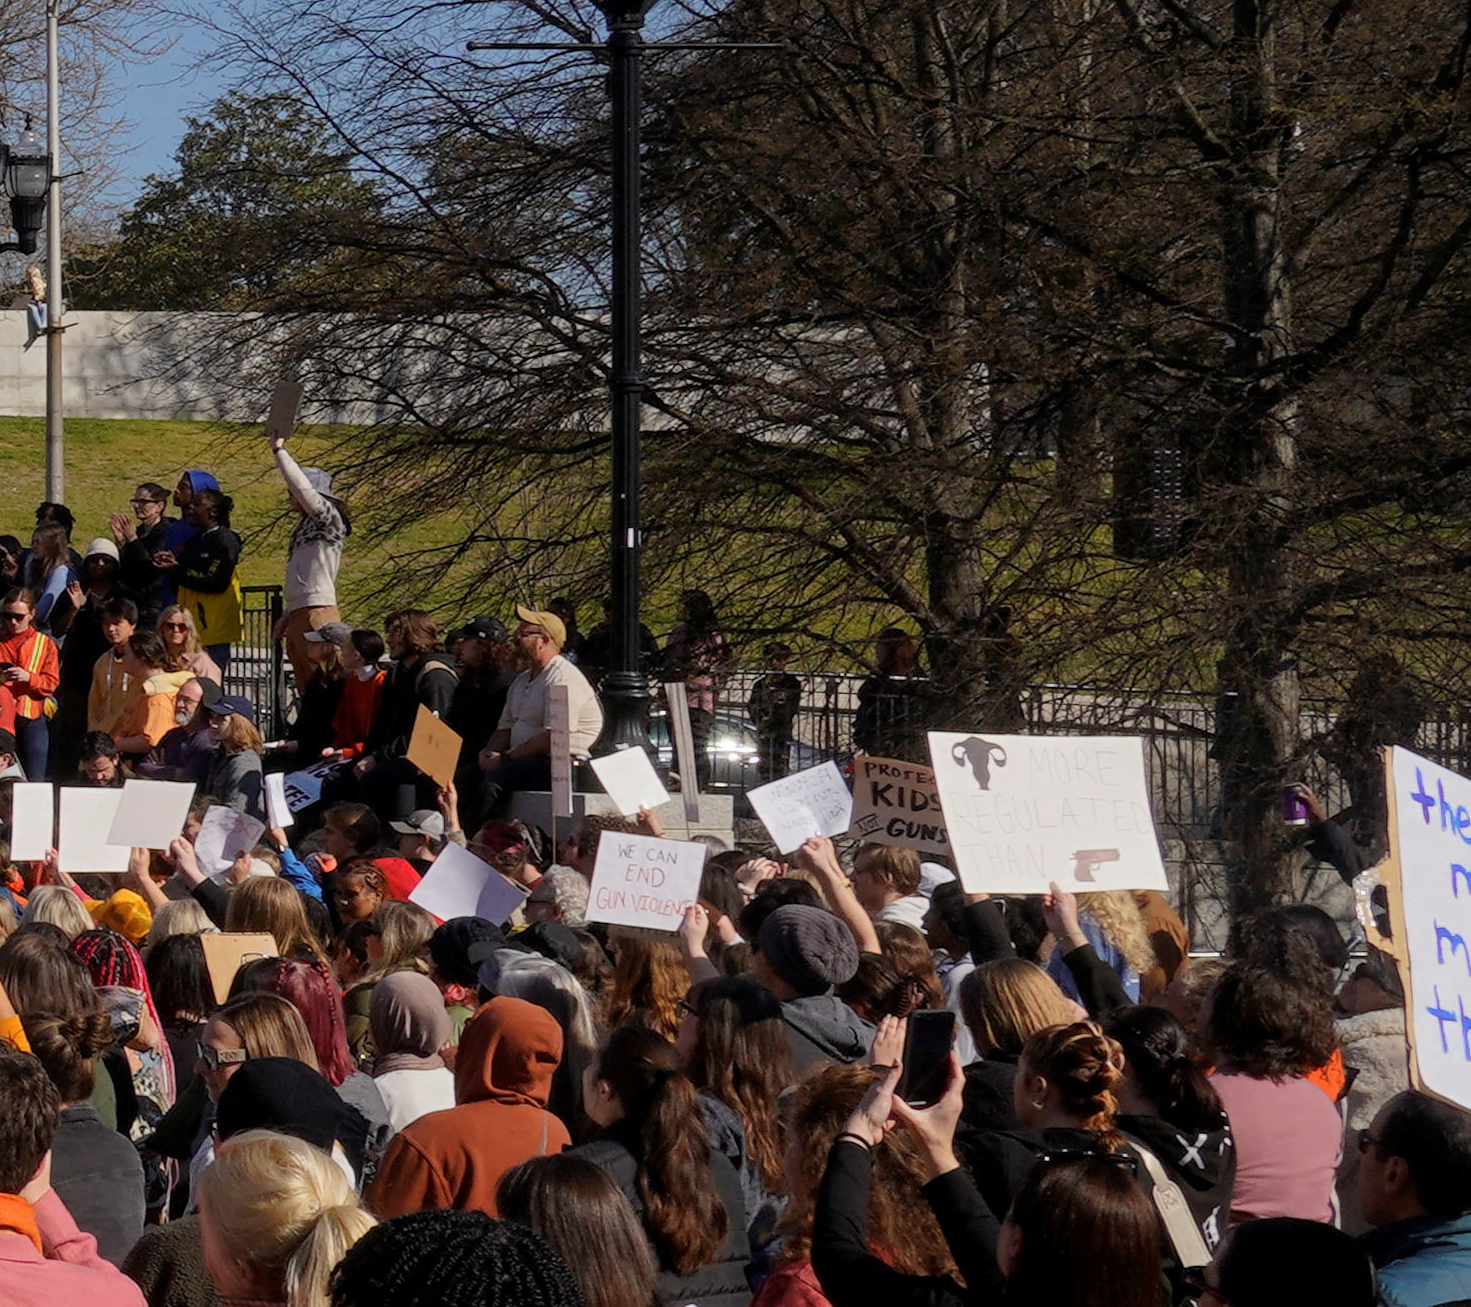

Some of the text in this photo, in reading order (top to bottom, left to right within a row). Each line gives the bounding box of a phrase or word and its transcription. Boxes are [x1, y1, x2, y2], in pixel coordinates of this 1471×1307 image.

[1027, 747, 1117, 788] MORE
[886, 817, 949, 843] GUNS
[617, 844, 678, 865] WE CAN
[961, 844, 1047, 880] THAN
[625, 865, 666, 888] END
[595, 885, 626, 911] GUN
